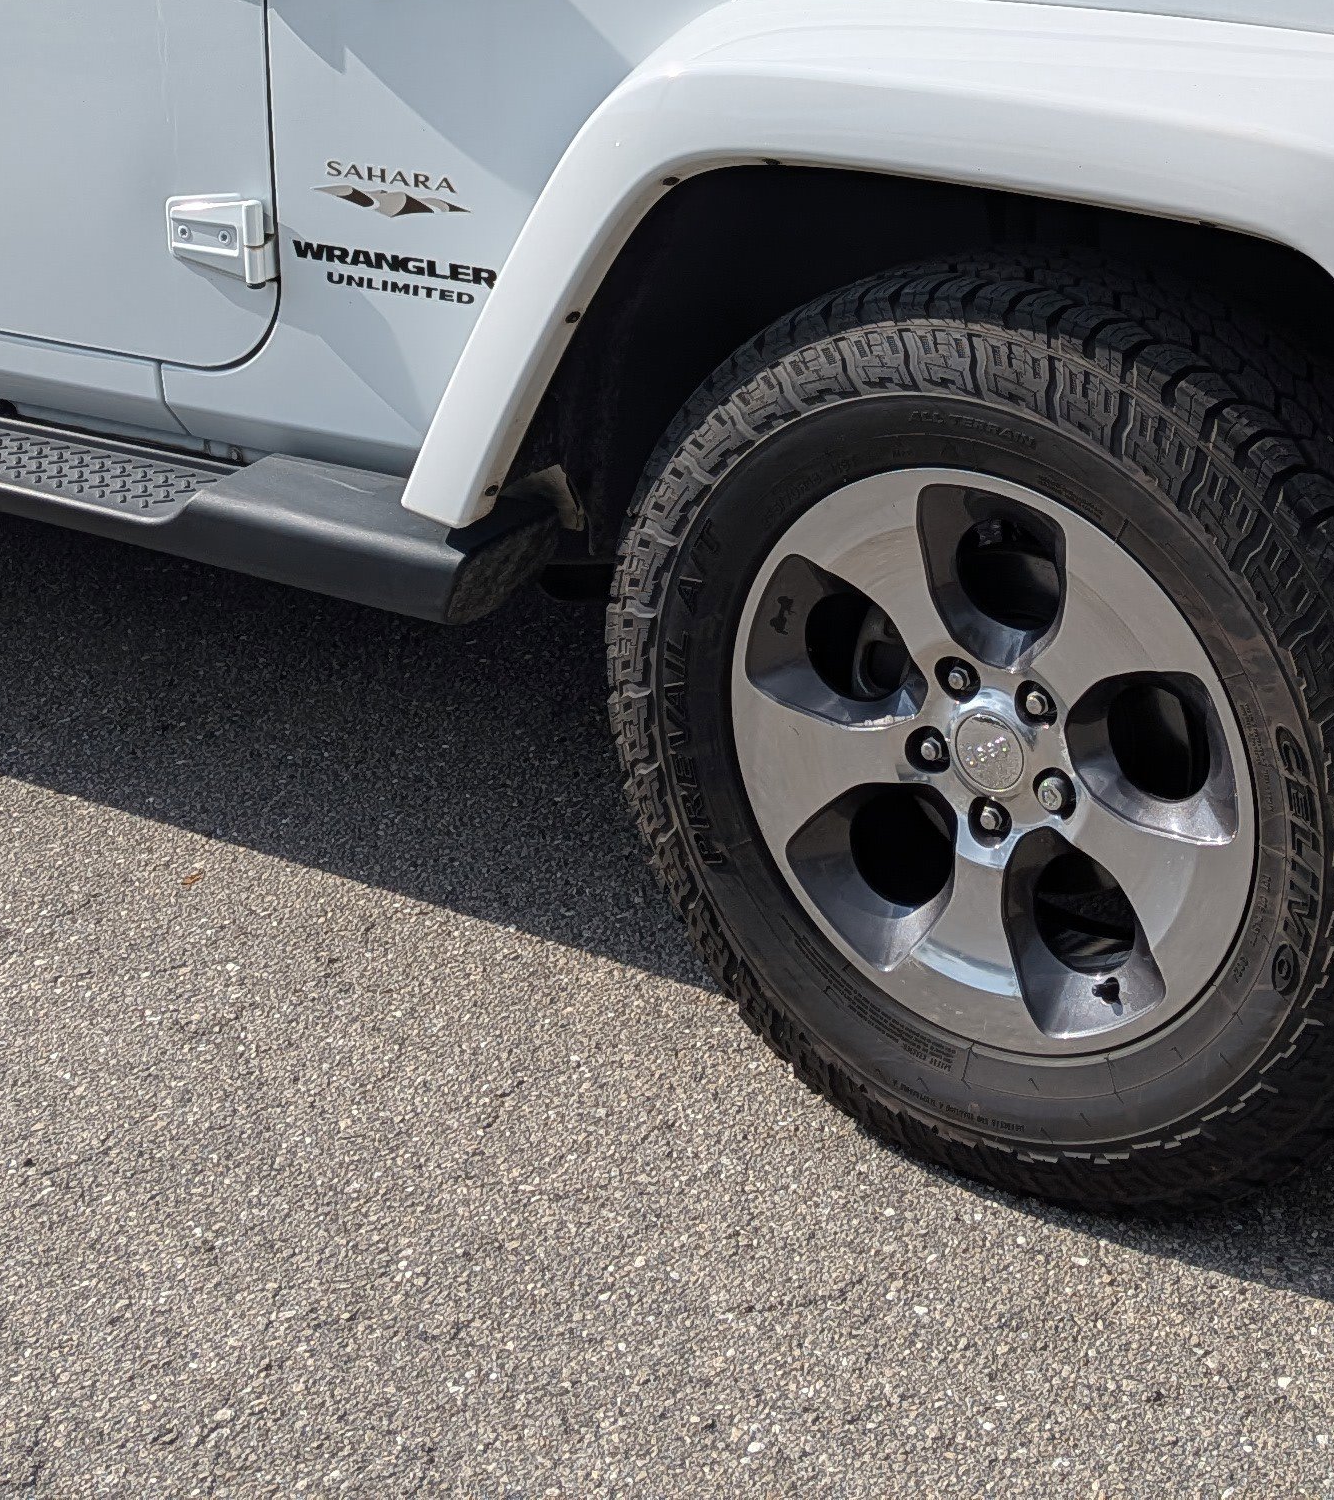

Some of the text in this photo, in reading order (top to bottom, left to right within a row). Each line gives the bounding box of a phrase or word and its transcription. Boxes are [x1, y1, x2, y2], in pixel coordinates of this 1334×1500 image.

[326, 160, 458, 194] SAHARA
[292, 239, 498, 290] WRANGLER
[326, 271, 475, 305] UNLIMITED
[663, 630, 728, 867] PREVAIL
[1272, 722, 1322, 996] CELIMO
